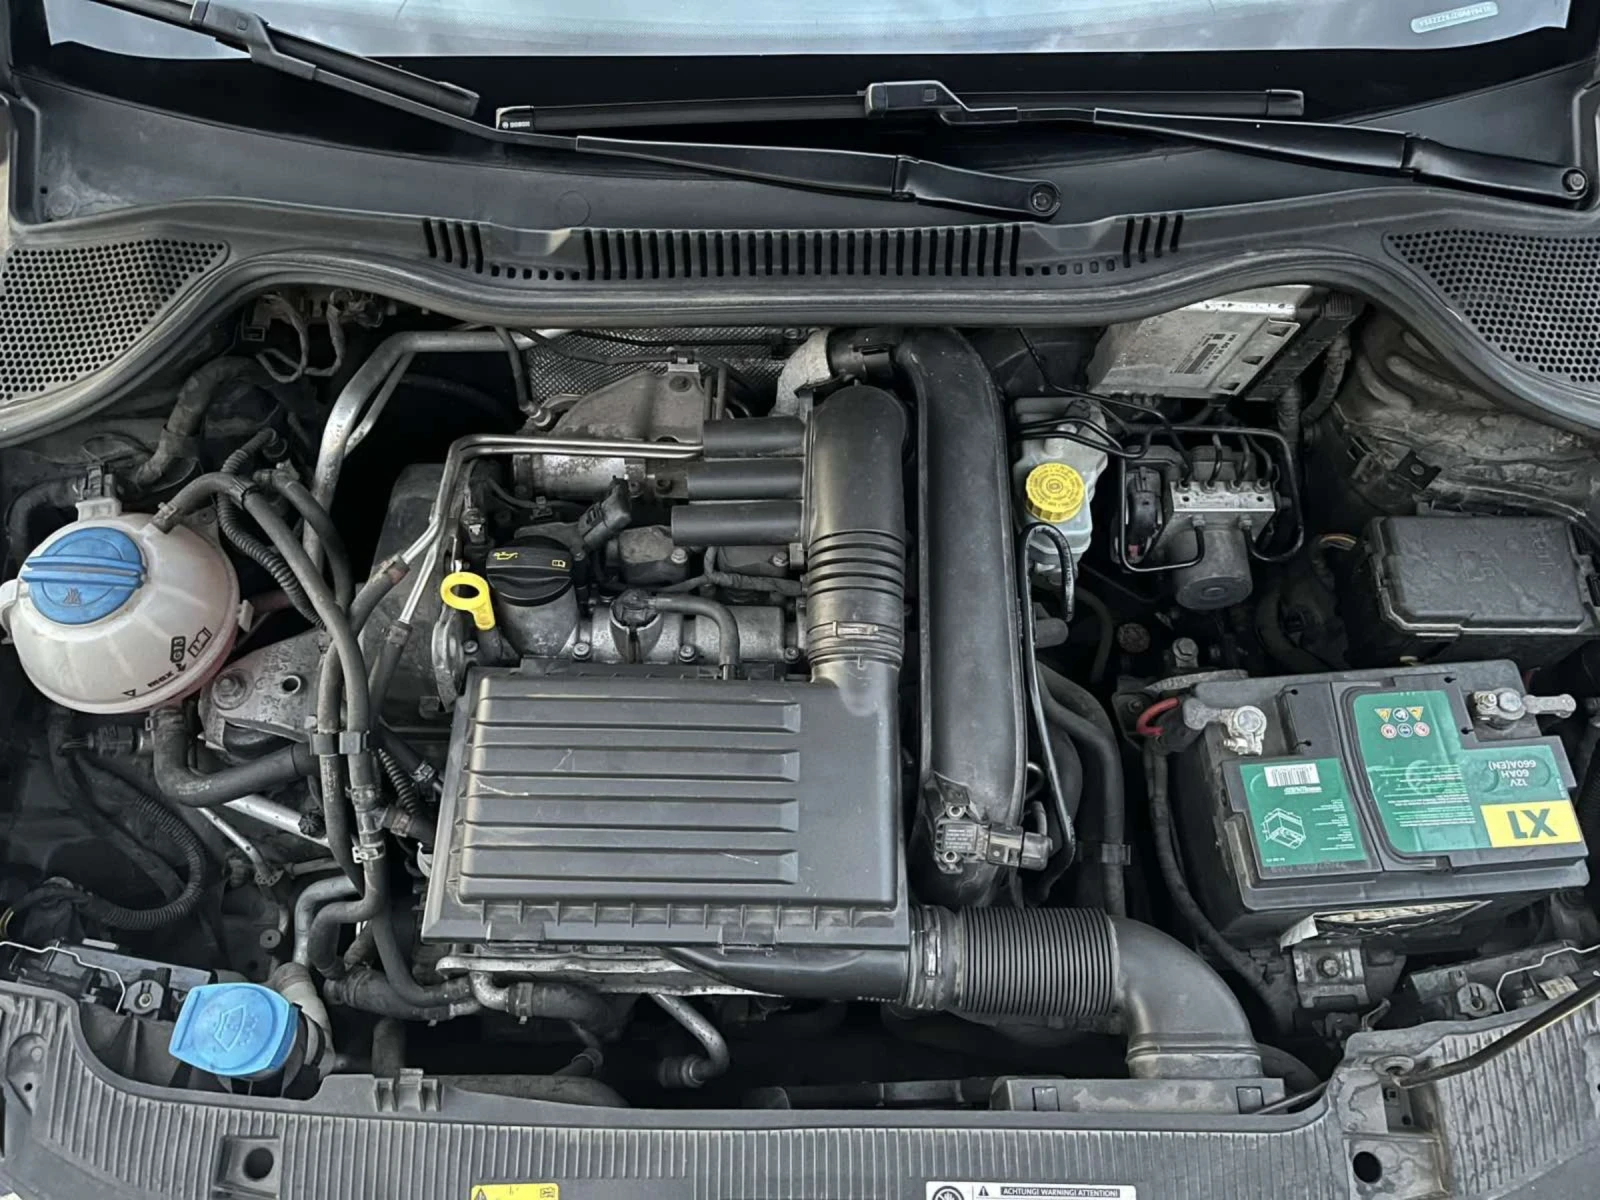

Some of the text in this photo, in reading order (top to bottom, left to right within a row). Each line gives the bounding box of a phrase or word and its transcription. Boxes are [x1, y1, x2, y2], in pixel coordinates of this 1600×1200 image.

[173, 638, 183, 660] G13
[147, 671, 174, 687] max
[1488, 759, 1536, 770] 660A(EN)
[1500, 769, 1529, 778] 60AH
[1509, 778, 1528, 787] 12V
[1506, 808, 1558, 839] X1
